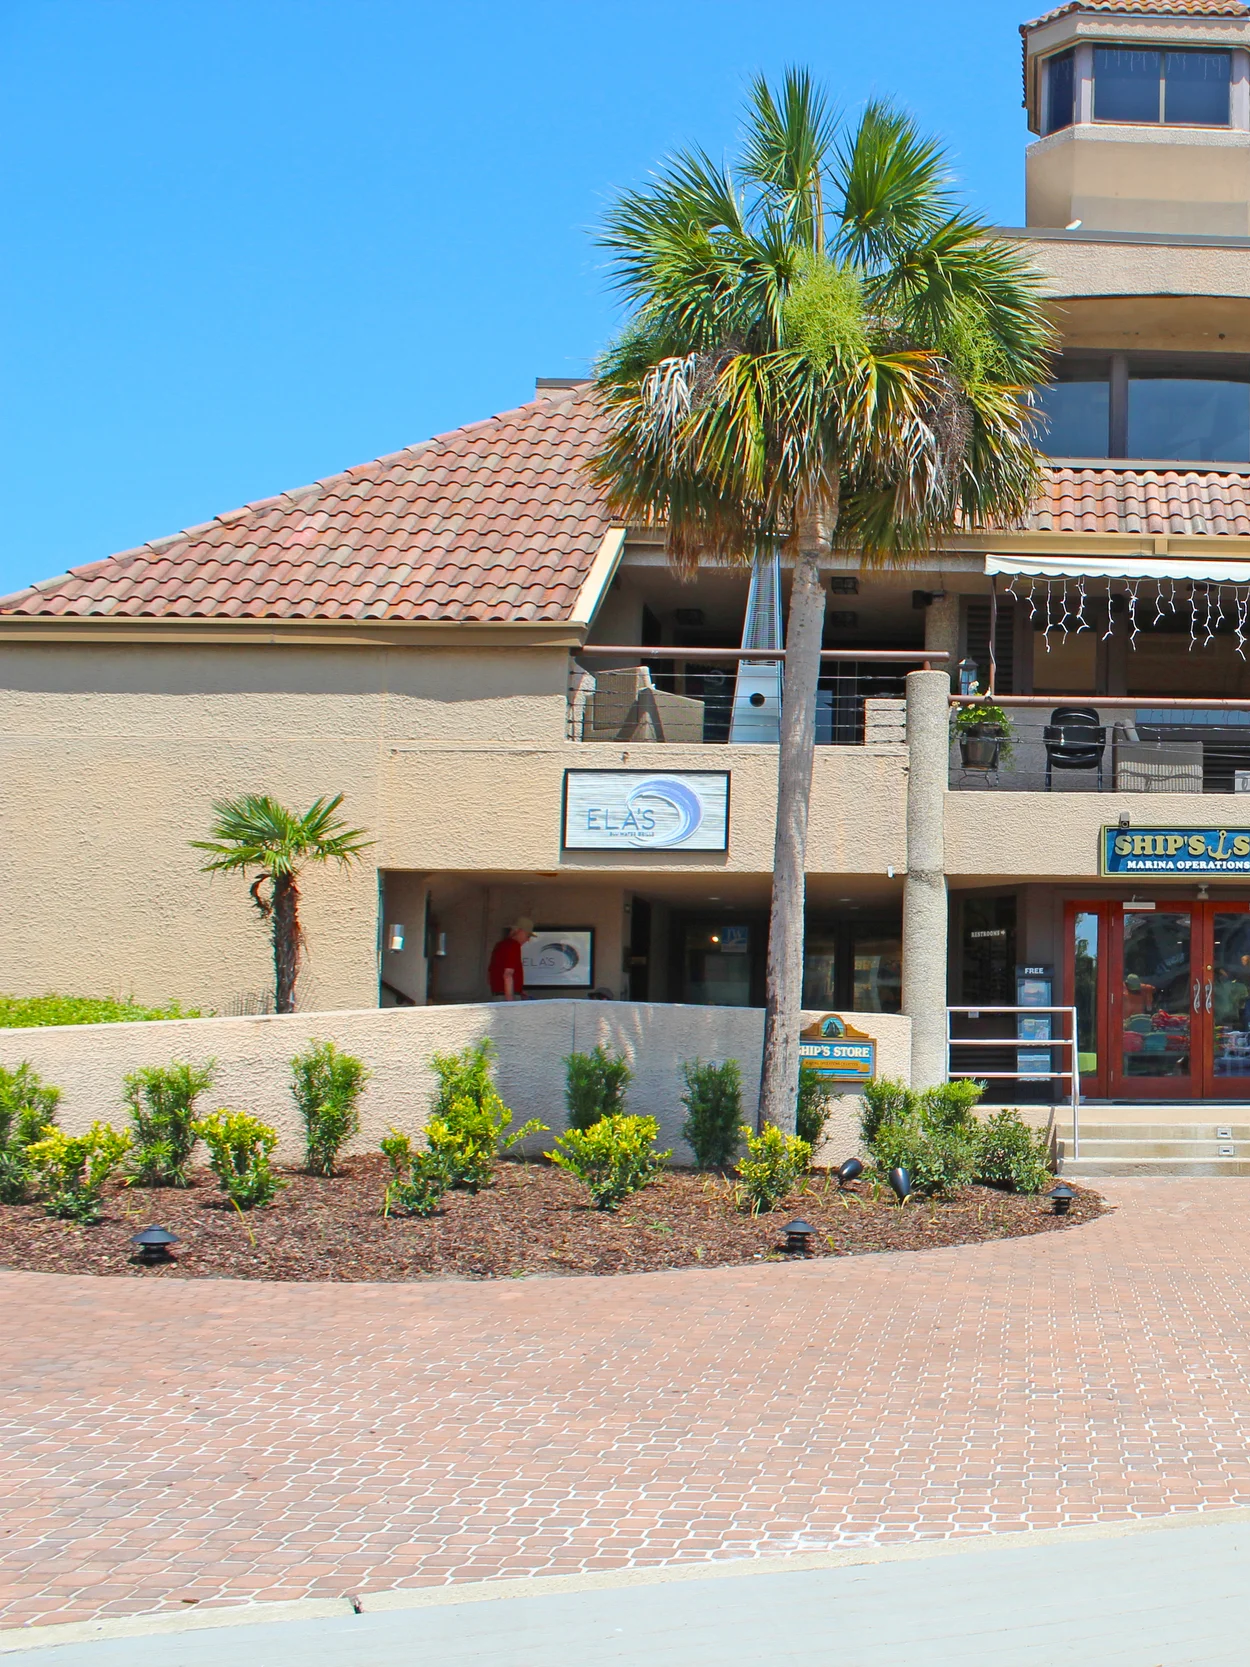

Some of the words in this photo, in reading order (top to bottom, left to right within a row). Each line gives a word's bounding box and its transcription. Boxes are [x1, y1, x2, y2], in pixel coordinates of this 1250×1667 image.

[587, 808, 656, 830] ELA'S
[1114, 835, 1207, 857] SHIP'S
[1127, 860, 1174, 870] MARINA
[971, 930, 1000, 938] RESTROOMS
[522, 957, 555, 967] ELA'S
[833, 1046, 870, 1058] STORE
